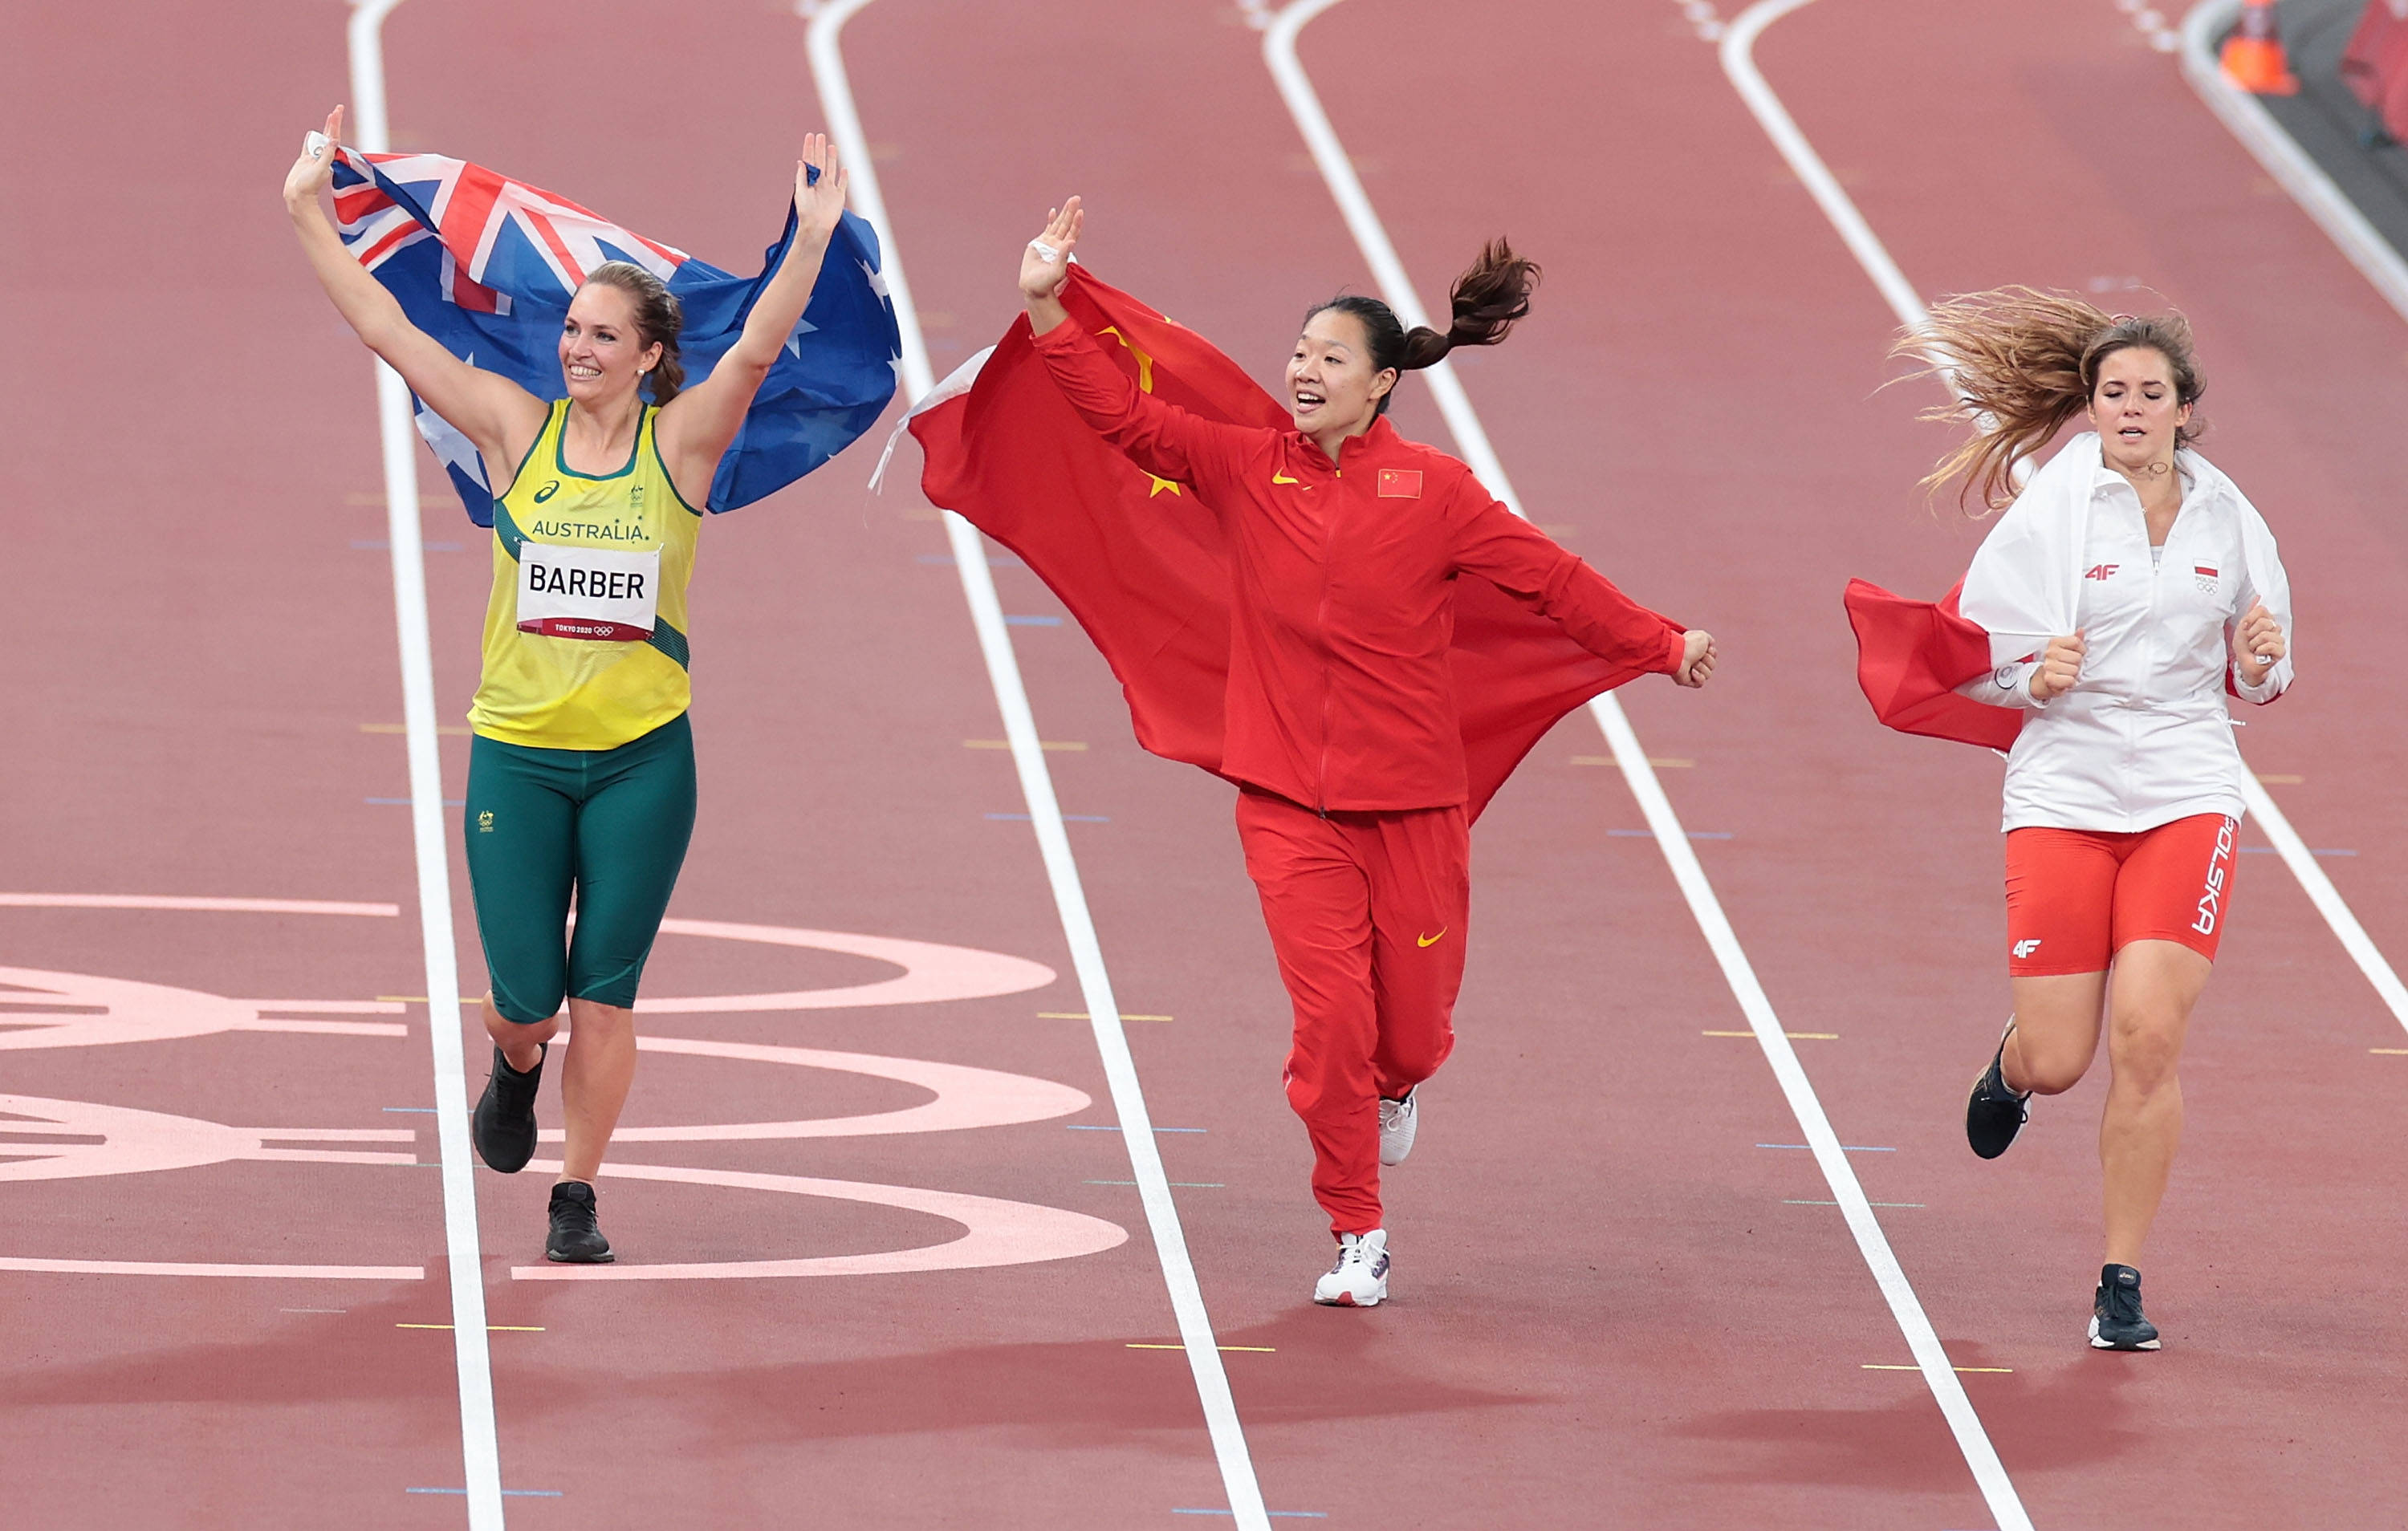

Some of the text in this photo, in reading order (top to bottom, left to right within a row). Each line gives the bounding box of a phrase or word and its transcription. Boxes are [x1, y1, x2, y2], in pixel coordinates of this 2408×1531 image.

[2085, 564, 2120, 581] 4F
[530, 564, 644, 599] BARBER
[555, 624, 576, 632] TOKYO
[2012, 940, 2041, 958] 4F
